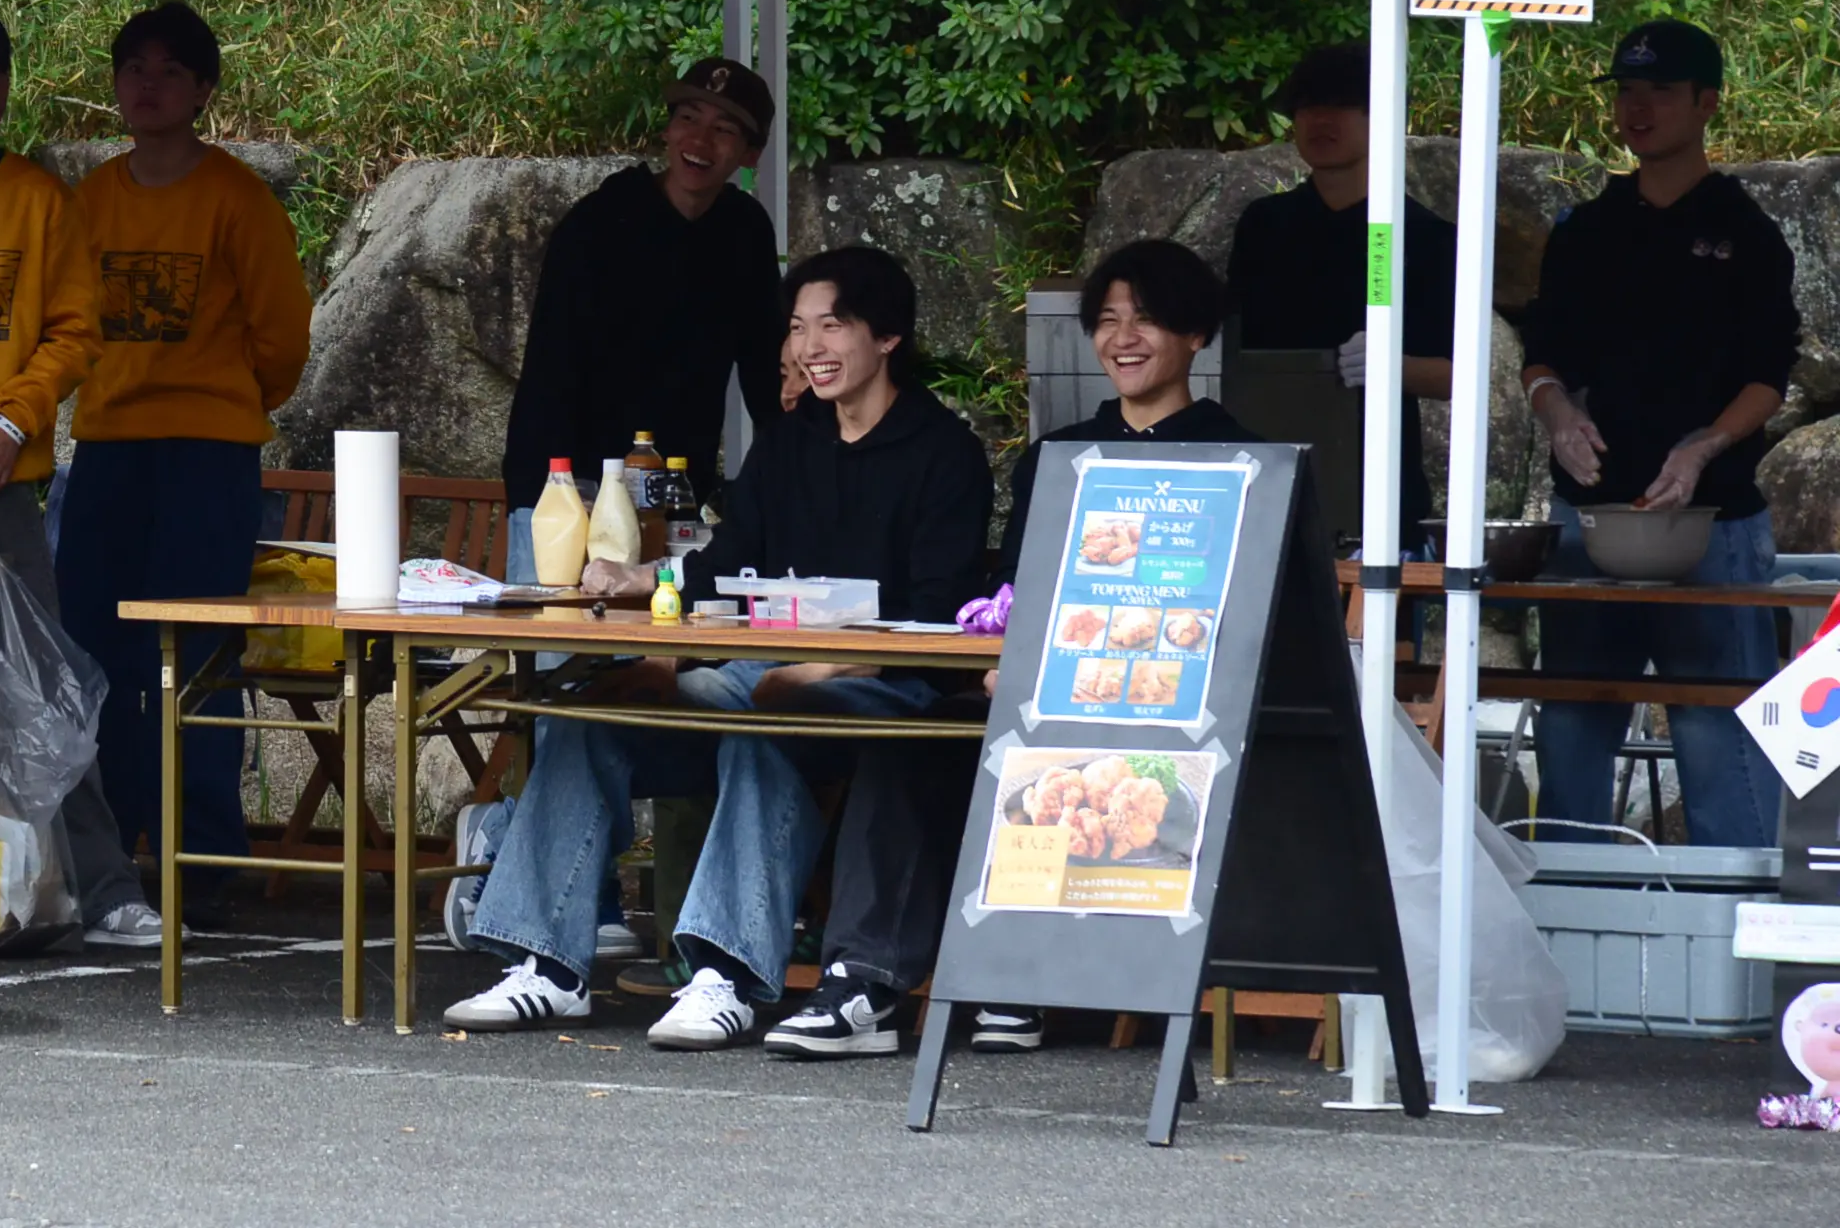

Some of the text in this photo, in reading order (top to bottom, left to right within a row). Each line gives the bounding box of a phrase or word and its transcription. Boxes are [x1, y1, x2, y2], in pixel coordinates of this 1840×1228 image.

[1159, 497, 1206, 514] MENU
[1148, 520, 1196, 534] からあげ
[1090, 583, 1191, 600] TOPPING MENU
